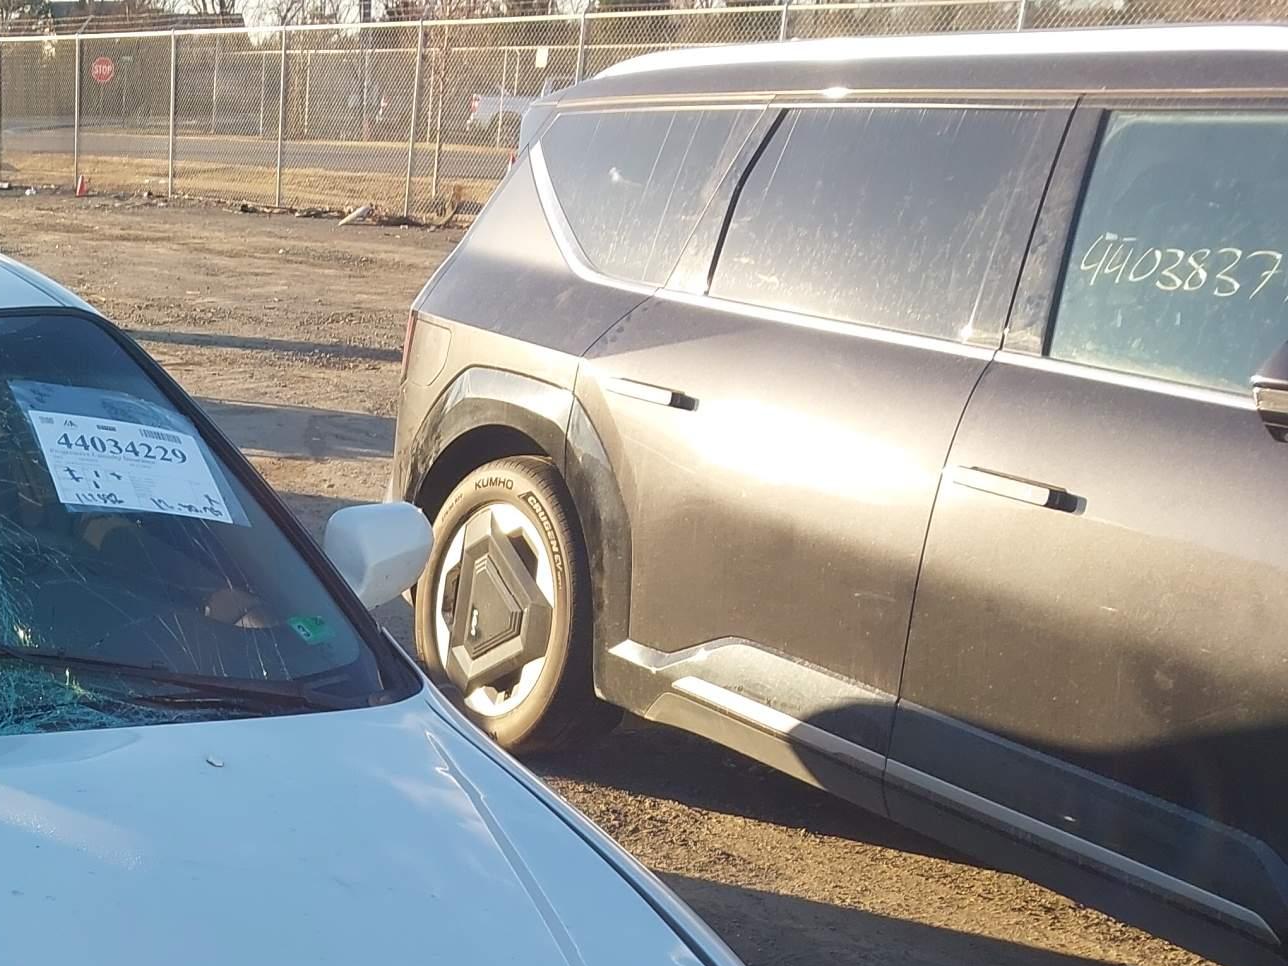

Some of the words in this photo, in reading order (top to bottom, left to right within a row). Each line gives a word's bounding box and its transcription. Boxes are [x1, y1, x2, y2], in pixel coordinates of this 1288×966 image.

[93, 64, 113, 75] STOP
[1081, 234, 1288, 302] 4403837
[57, 432, 187, 464] 44034229
[474, 477, 514, 491] KUMHO
[527, 494, 560, 553] CRUGEN
